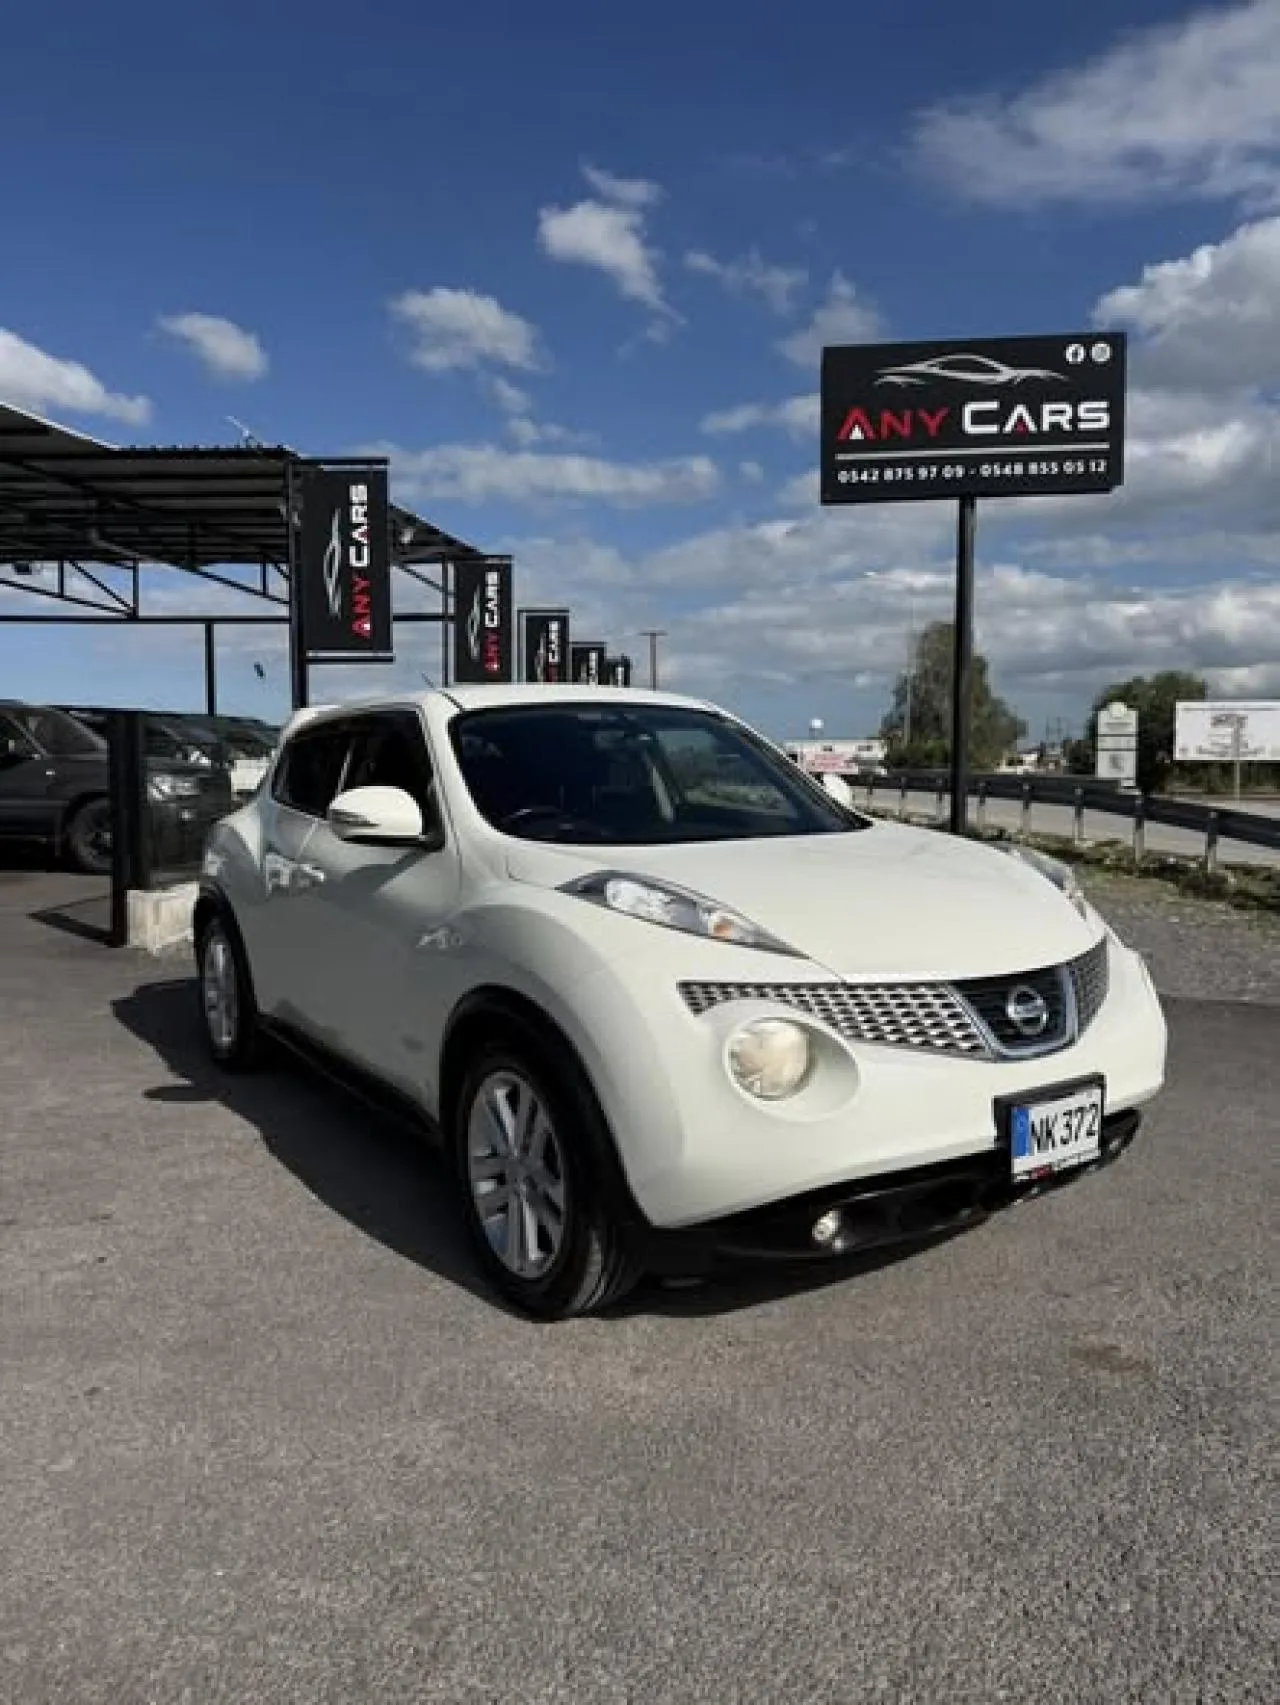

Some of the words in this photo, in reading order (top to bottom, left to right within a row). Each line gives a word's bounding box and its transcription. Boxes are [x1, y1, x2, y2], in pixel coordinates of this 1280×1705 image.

[836, 407, 949, 440] ANY
[962, 400, 1111, 434] CARS
[349, 484, 370, 568] CARS
[351, 574, 371, 639] ANY
[1060, 1103, 1099, 1145] 372
